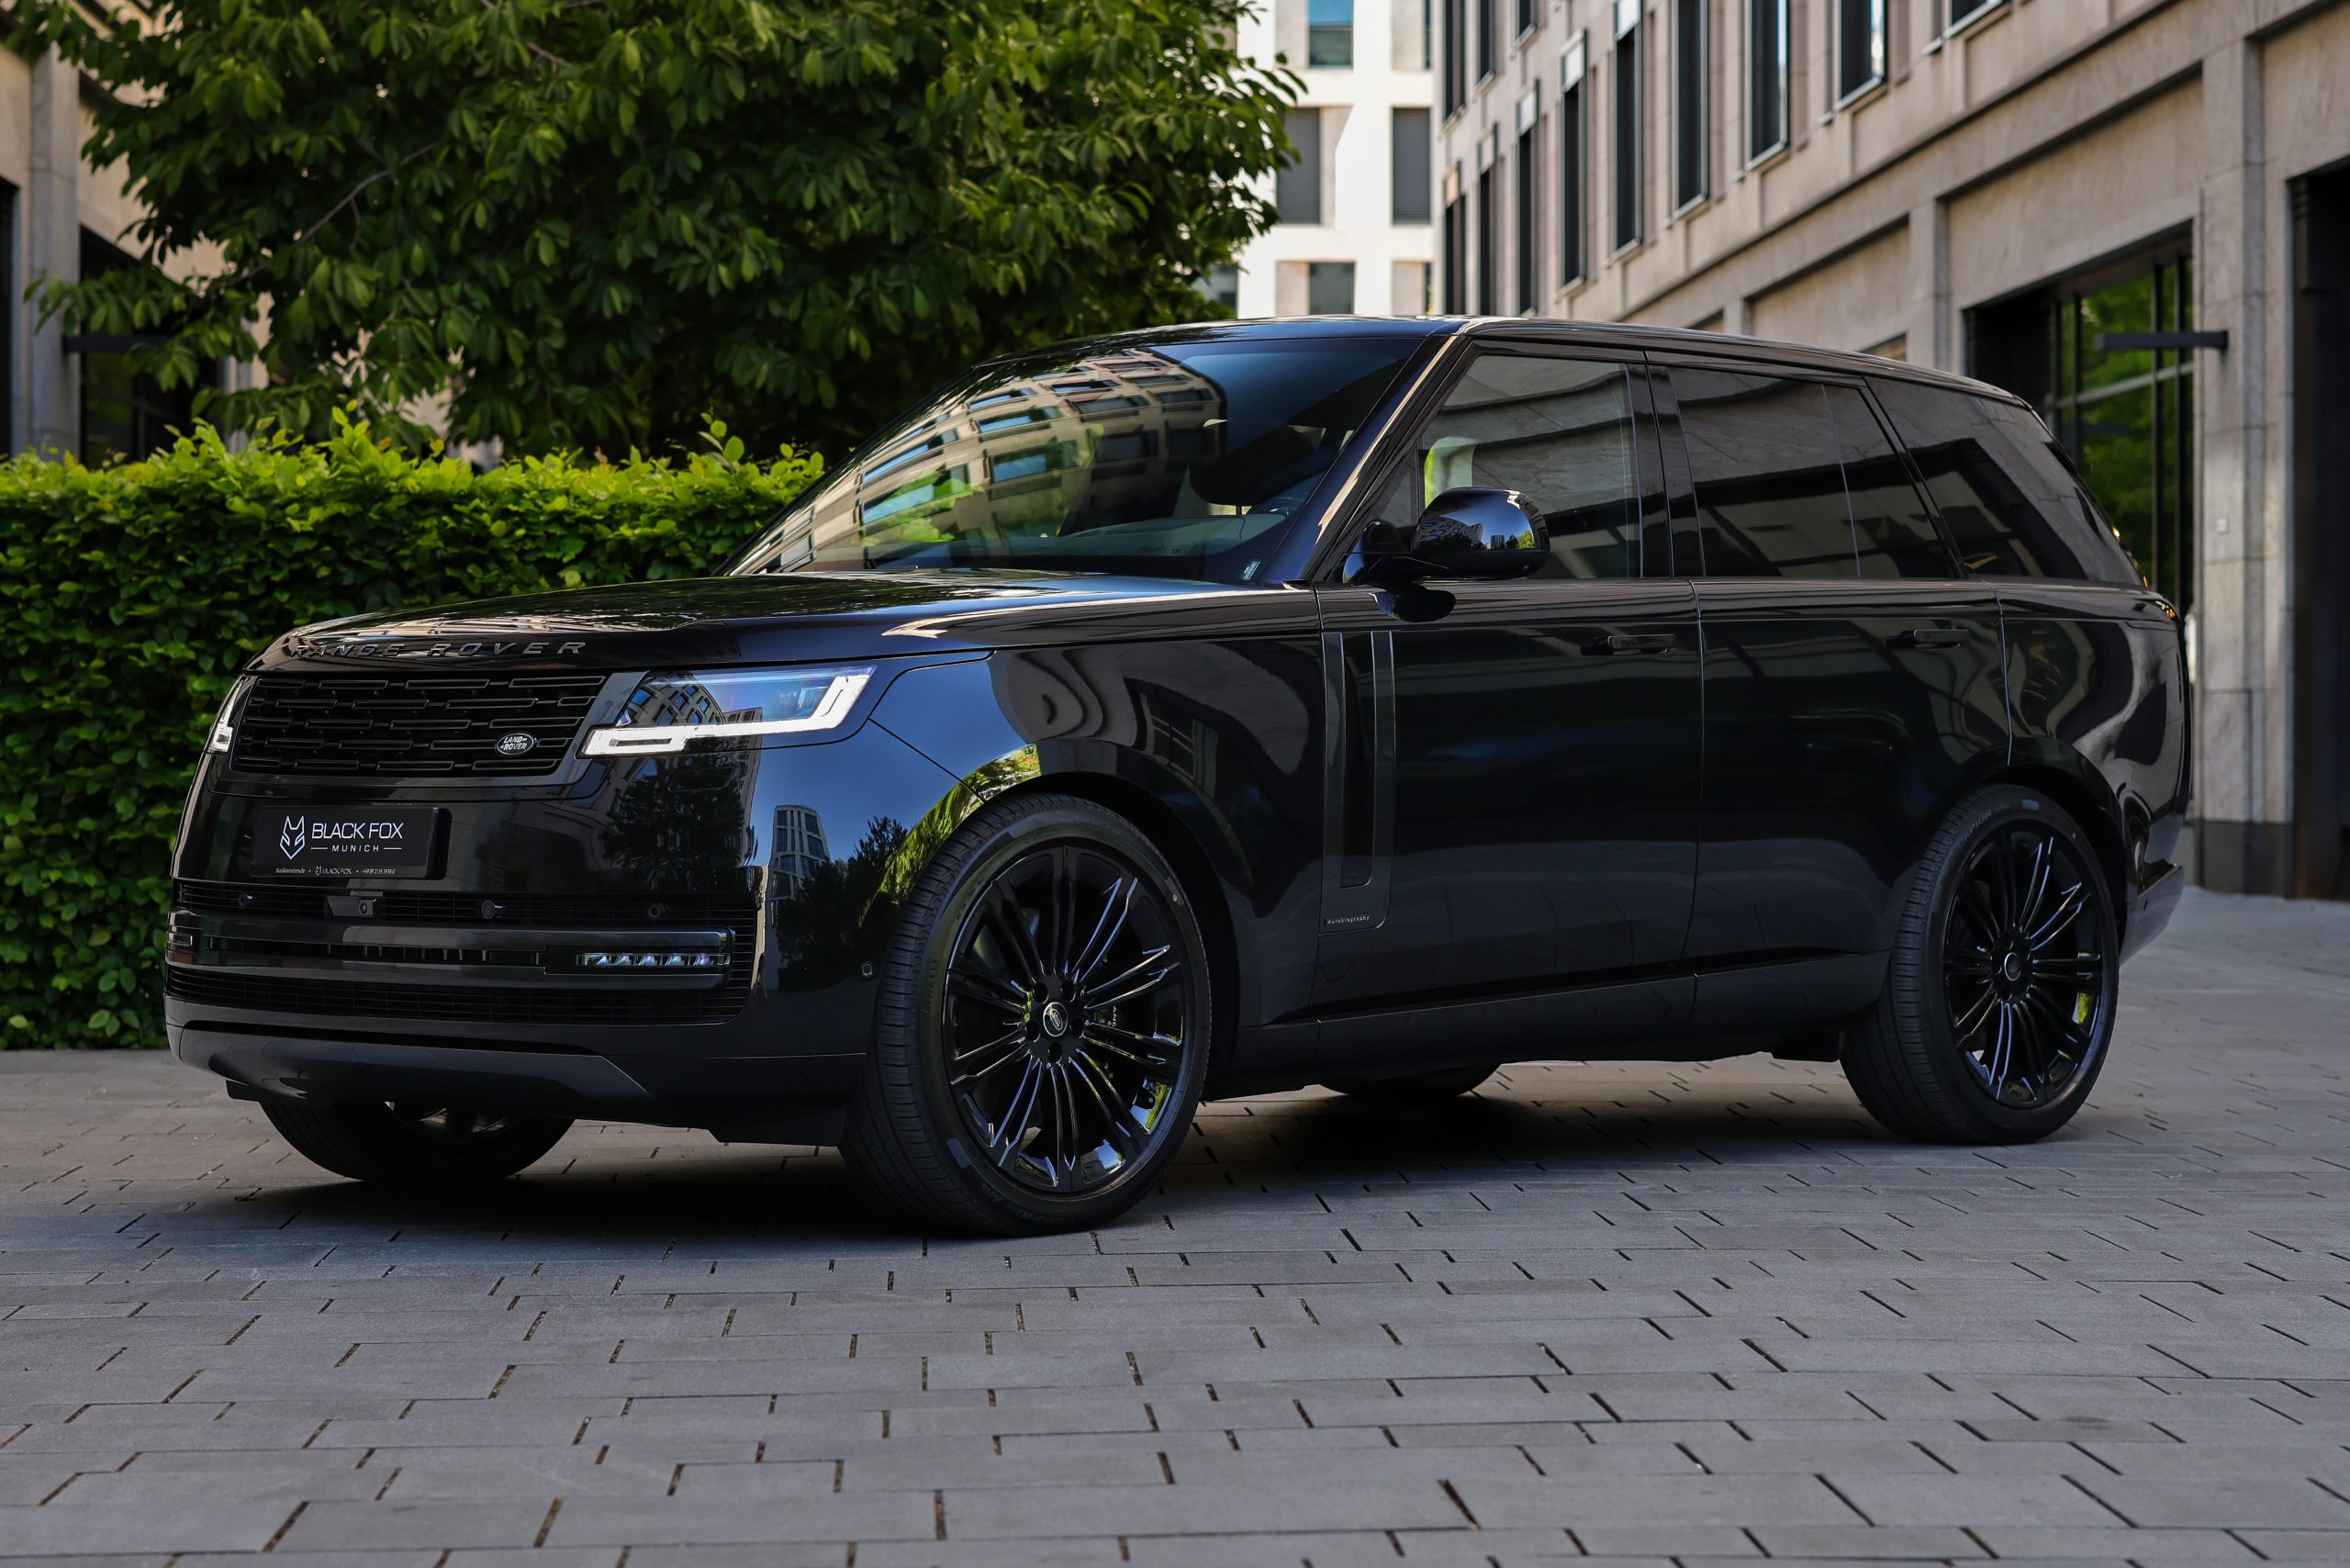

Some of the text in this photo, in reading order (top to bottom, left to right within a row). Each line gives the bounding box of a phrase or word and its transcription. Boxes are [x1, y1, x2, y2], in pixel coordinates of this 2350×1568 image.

[290, 642, 587, 658] RANGE ROVER
[503, 735, 523, 744] LAND
[503, 743, 528, 751] ROVER
[311, 823, 404, 839] BLACK FOX
